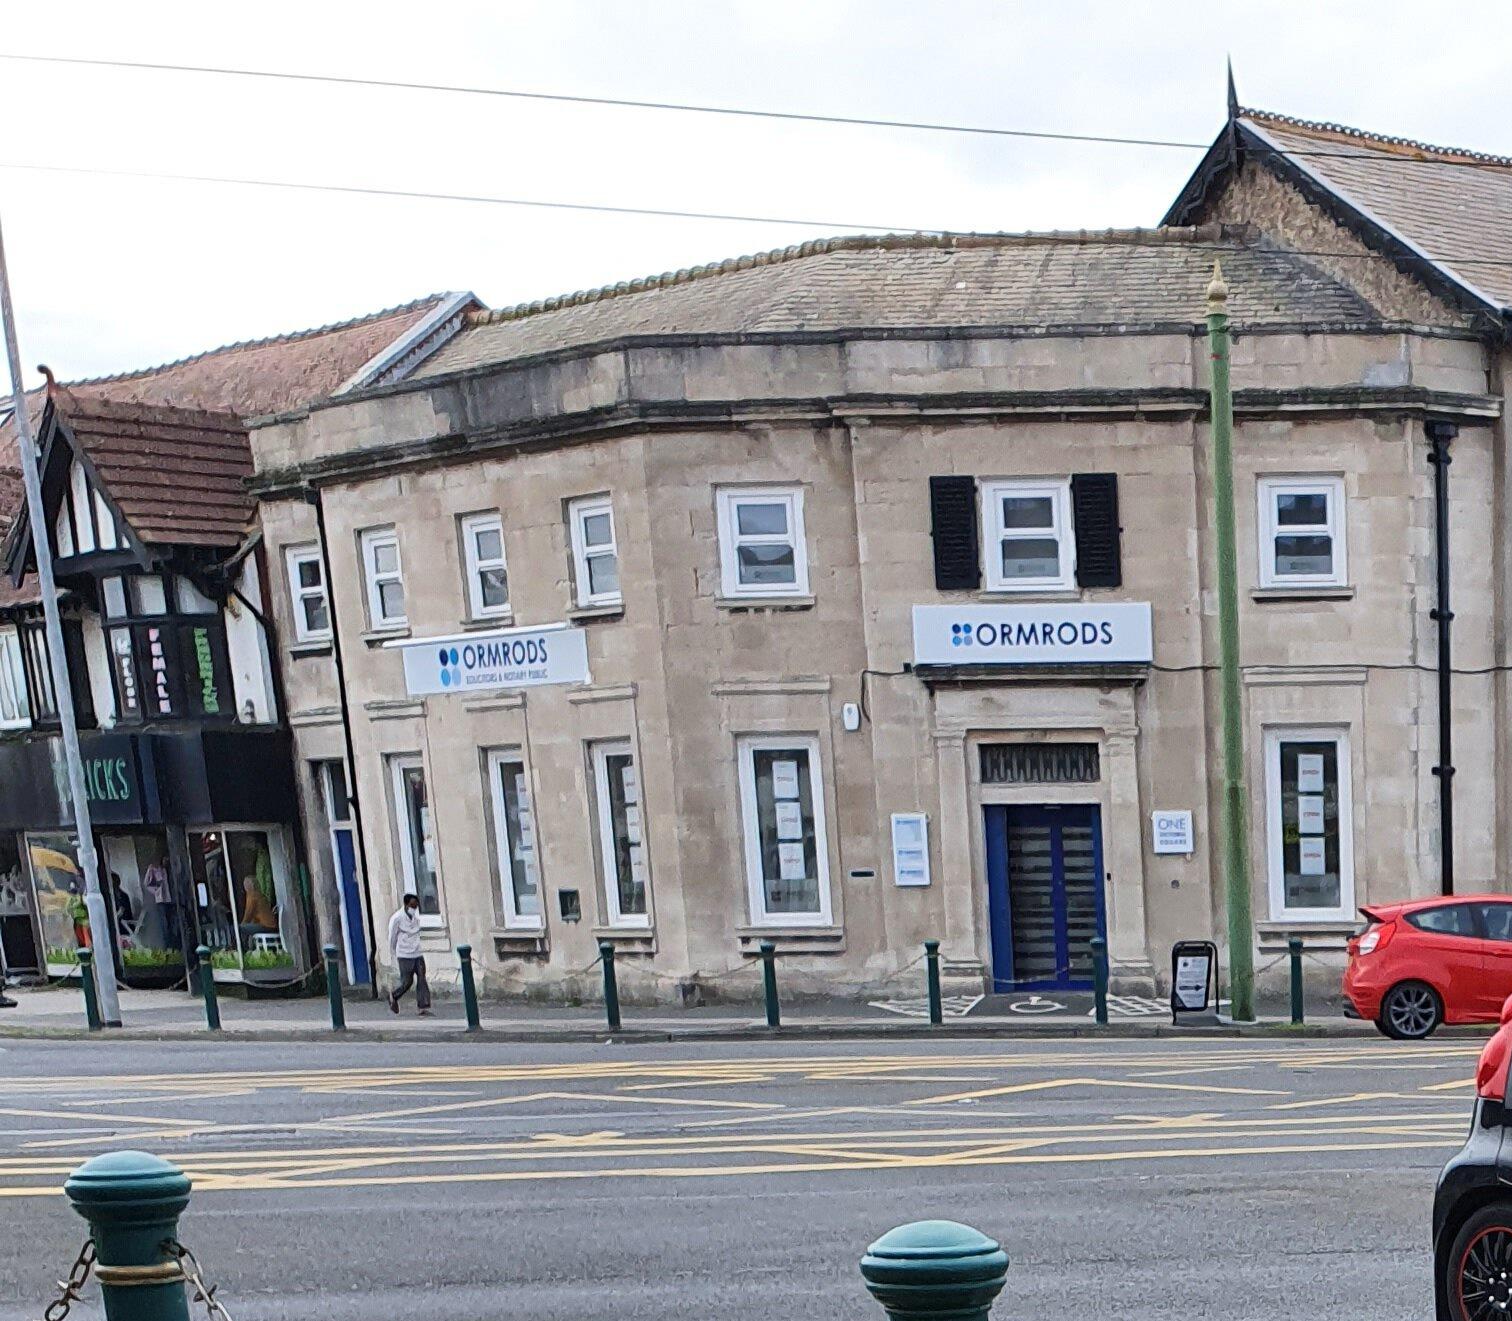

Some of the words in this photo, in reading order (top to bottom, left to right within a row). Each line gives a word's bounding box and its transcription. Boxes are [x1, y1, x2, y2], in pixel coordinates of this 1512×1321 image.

[976, 621, 1113, 647] ORMRODS
[463, 637, 548, 670] ORMRODS
[1158, 818, 1186, 830] ONE
